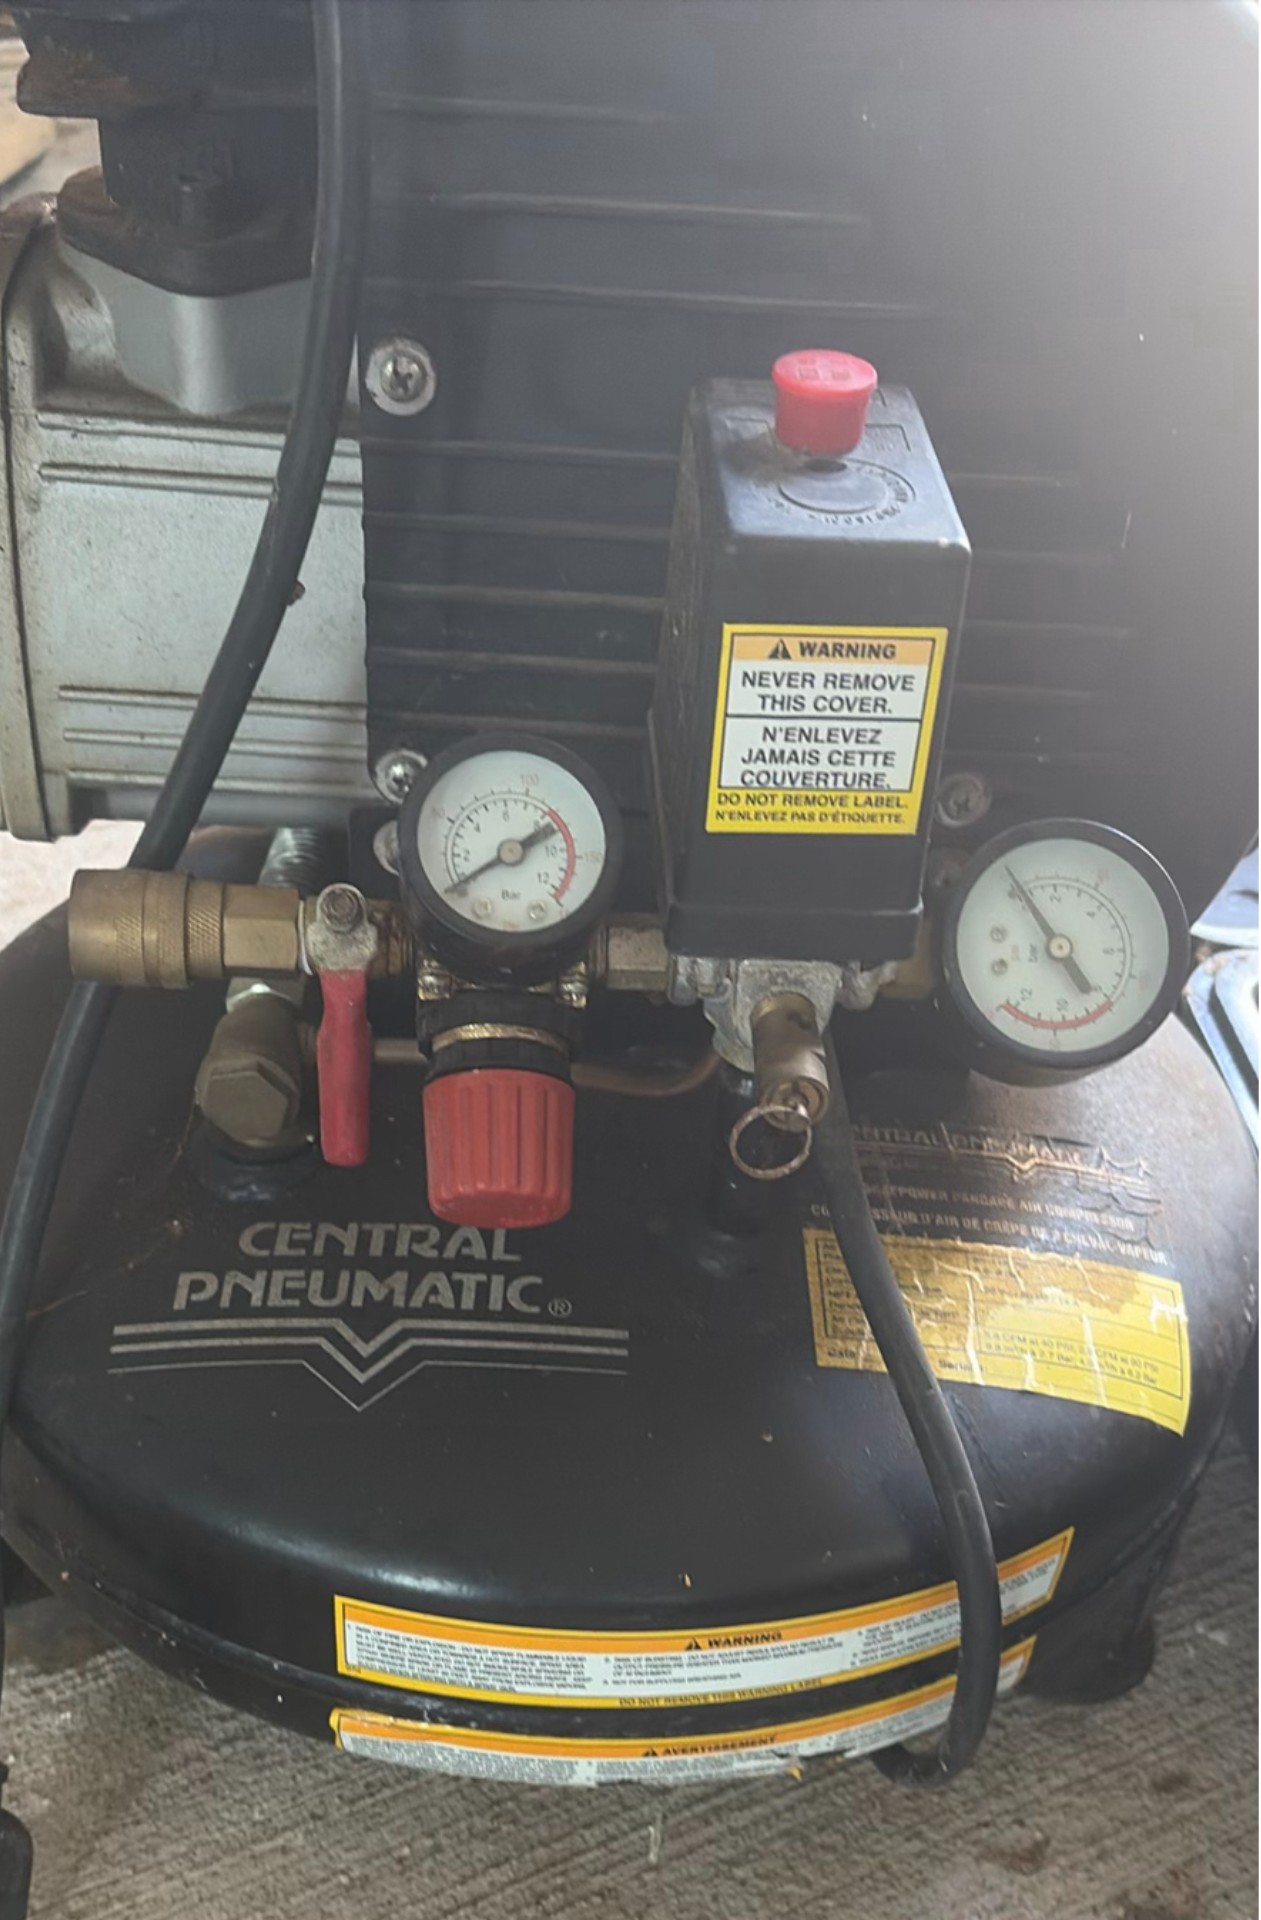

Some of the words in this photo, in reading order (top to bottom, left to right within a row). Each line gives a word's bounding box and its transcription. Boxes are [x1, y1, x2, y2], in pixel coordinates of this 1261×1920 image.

[799, 641, 897, 659] WARNING
[741, 670, 815, 689] NEVER
[823, 673, 915, 692] REMOVE
[757, 694, 806, 712] THIS
[813, 695, 893, 714] COVER.
[762, 725, 882, 745] N'ENLEVEZ
[741, 748, 820, 766] JAMAIS
[828, 750, 896, 768] CETTE
[519, 774, 540, 787] 100
[740, 769, 891, 790] COUVERTURE.
[717, 793, 741, 807] DO
[745, 793, 778, 807] NOT
[783, 794, 848, 808] REMOVE
[853, 795, 908, 810] LABEL.
[715, 810, 785, 822] N'ENLEVEZ
[790, 811, 814, 822] PAS
[545, 845, 557, 857] 10
[537, 872, 550, 886] 12
[238, 1221, 522, 1262] CENTRAL
[707, 1631, 784, 1648] WARNING
